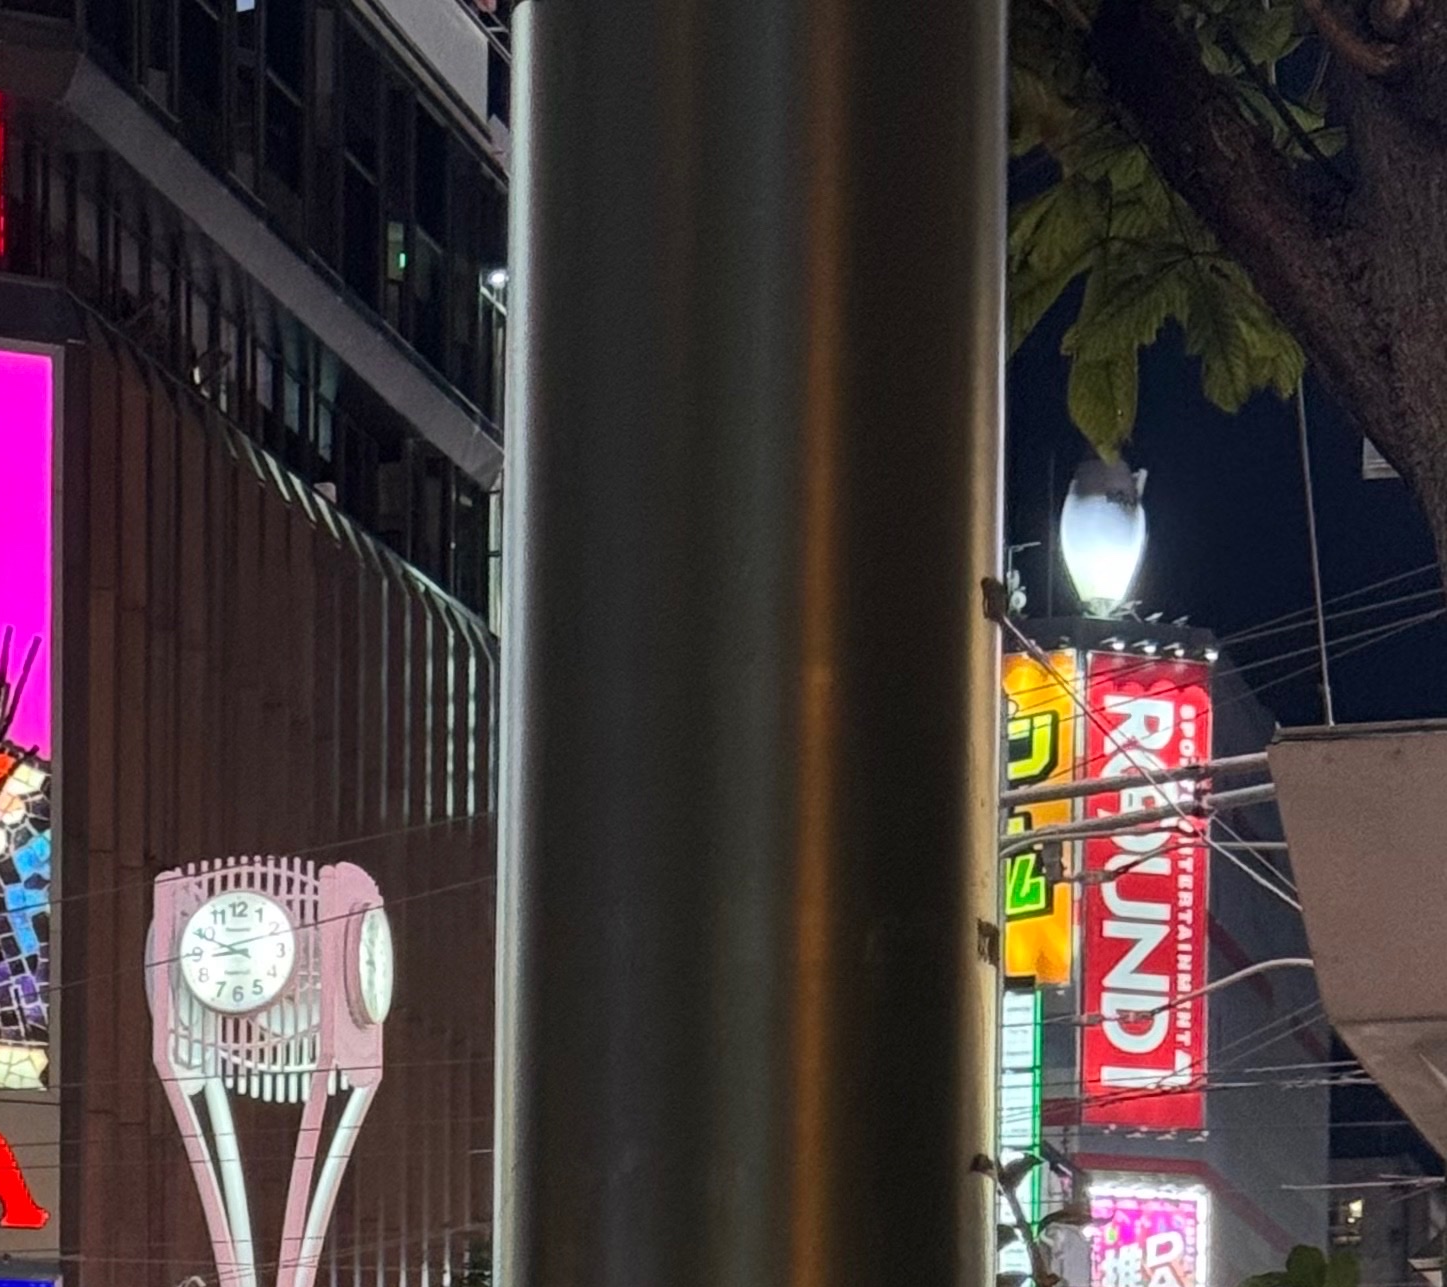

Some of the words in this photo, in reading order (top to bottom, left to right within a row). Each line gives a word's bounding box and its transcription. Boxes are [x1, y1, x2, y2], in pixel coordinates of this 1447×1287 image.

[229, 902, 248, 918] 12
[233, 986, 244, 1001] 6
[252, 980, 263, 995] 5
